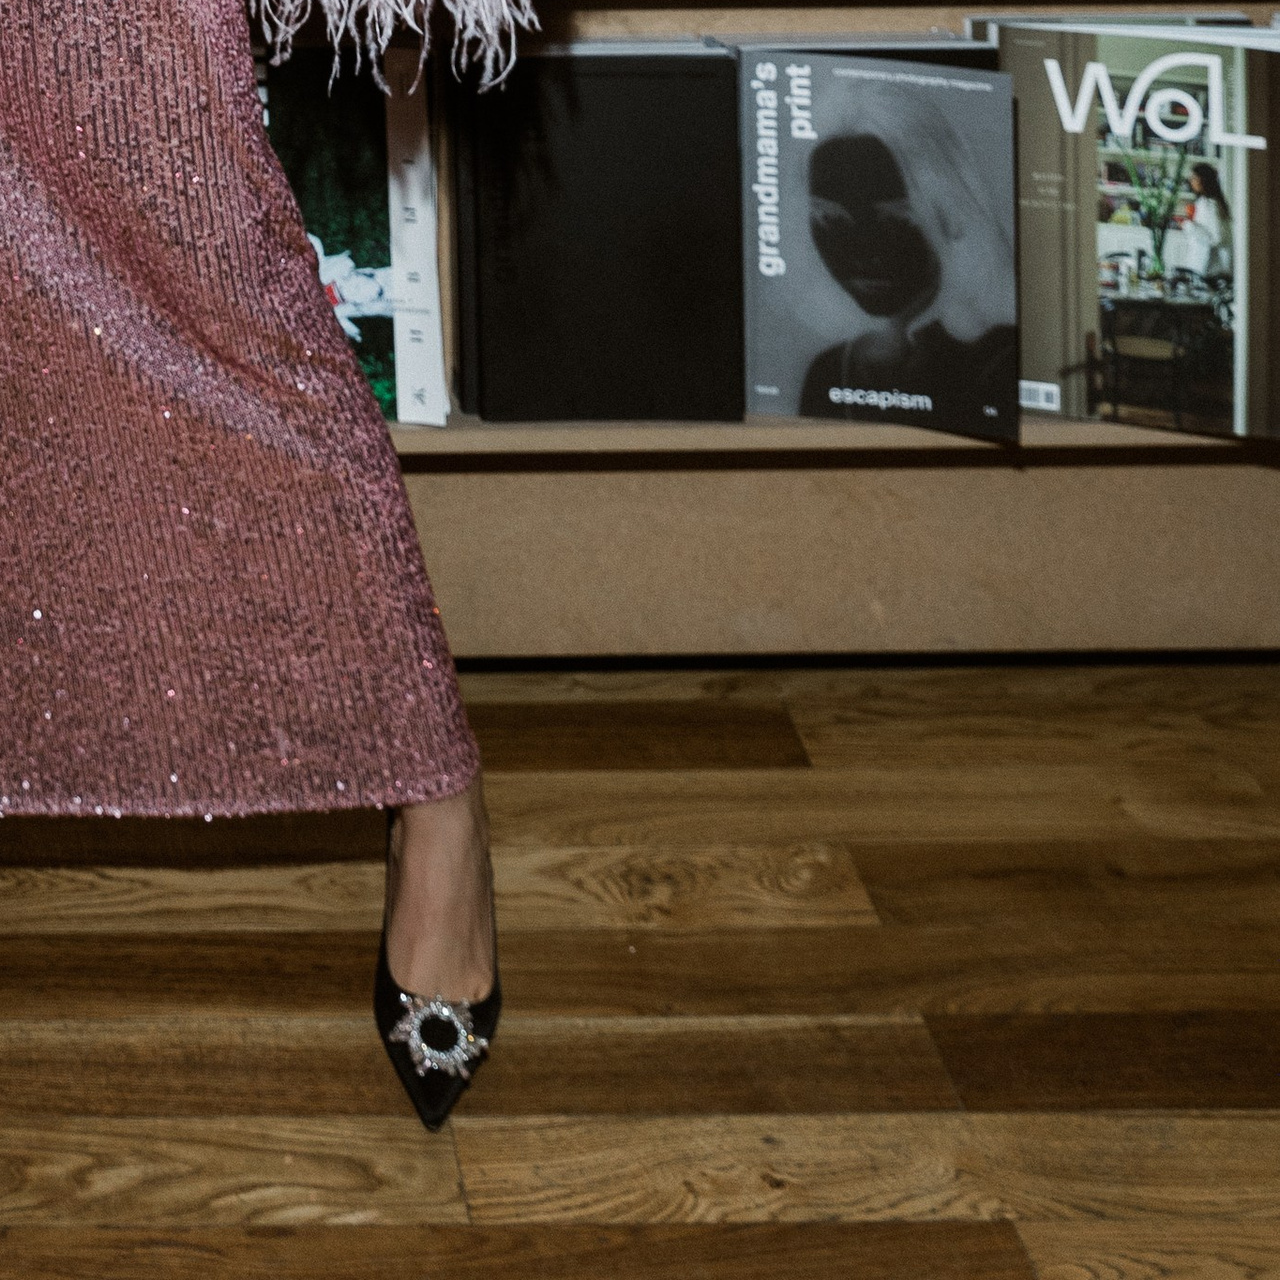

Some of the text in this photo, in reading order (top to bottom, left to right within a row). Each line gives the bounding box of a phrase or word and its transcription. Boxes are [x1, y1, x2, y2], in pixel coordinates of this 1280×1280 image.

[785, 64, 818, 139] print
[755, 61, 786, 277] grandmama's
[828, 387, 934, 411] escapism
